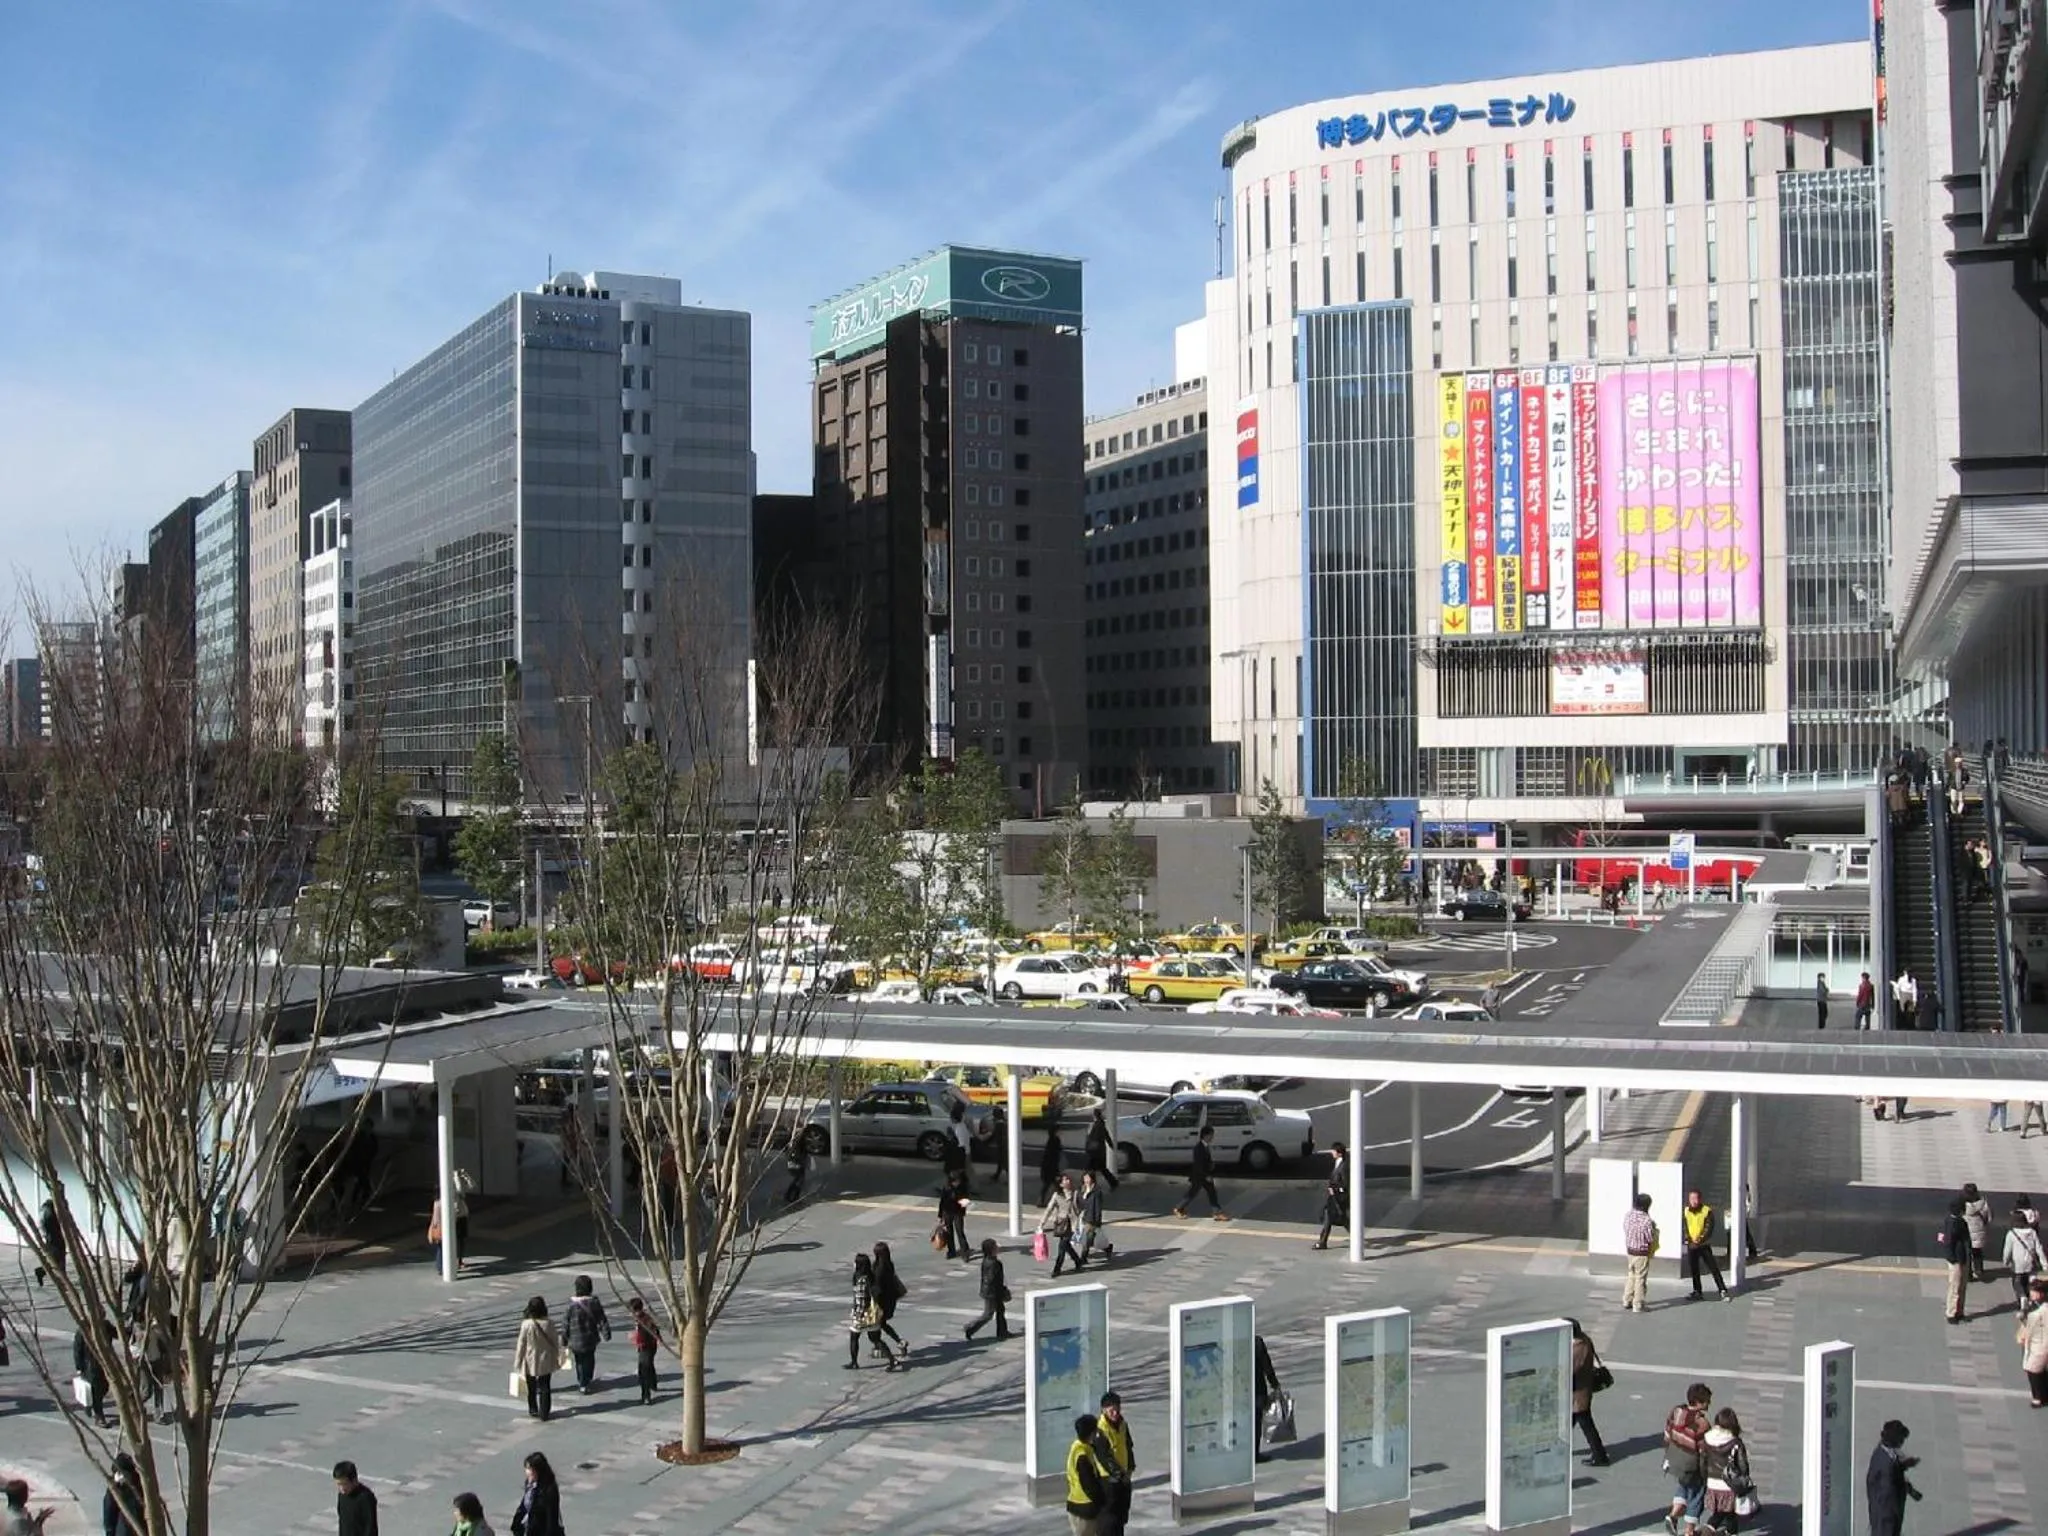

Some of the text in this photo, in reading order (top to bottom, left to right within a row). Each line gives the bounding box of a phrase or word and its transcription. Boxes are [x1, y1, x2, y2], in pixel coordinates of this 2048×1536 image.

[1316, 92, 1577, 150] 博多バスターミナル
[1549, 369, 1569, 383] 8F
[1627, 389, 1727, 418] さらに、
[1633, 426, 1723, 454] 生まれ
[1472, 420, 1486, 504] マクドナルド
[1617, 504, 1743, 536] 博多バス
[1614, 546, 1750, 577] ターミナル
[1554, 547, 1566, 620] オープン
